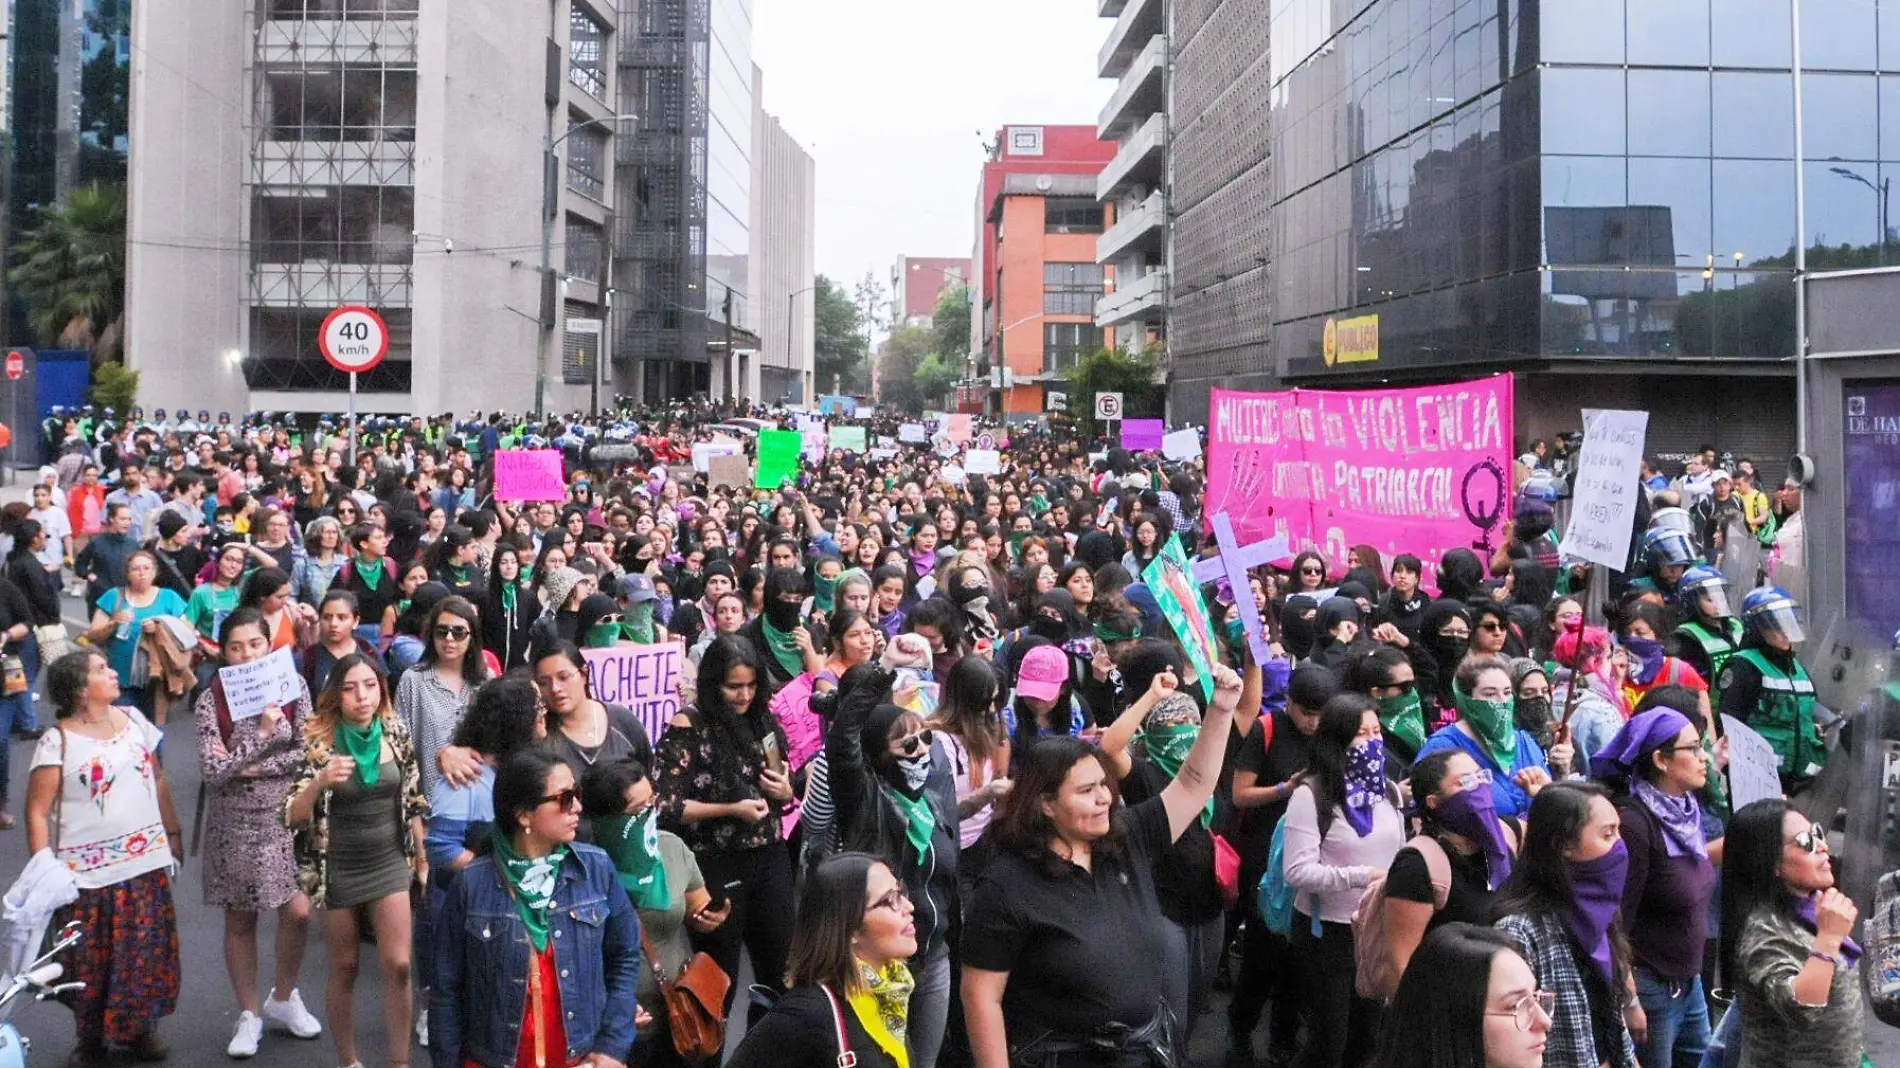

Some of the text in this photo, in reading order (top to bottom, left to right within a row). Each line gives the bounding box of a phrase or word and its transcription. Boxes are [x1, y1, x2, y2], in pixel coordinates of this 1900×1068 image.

[339, 322, 368, 340] 40
[338, 344, 369, 355] km/h
[1347, 390, 1502, 453] VIOLENCIA
[1848, 416, 1900, 432] DE HA
[1334, 459, 1460, 517] PATRIARCAL
[588, 651, 677, 702] ACHETE
